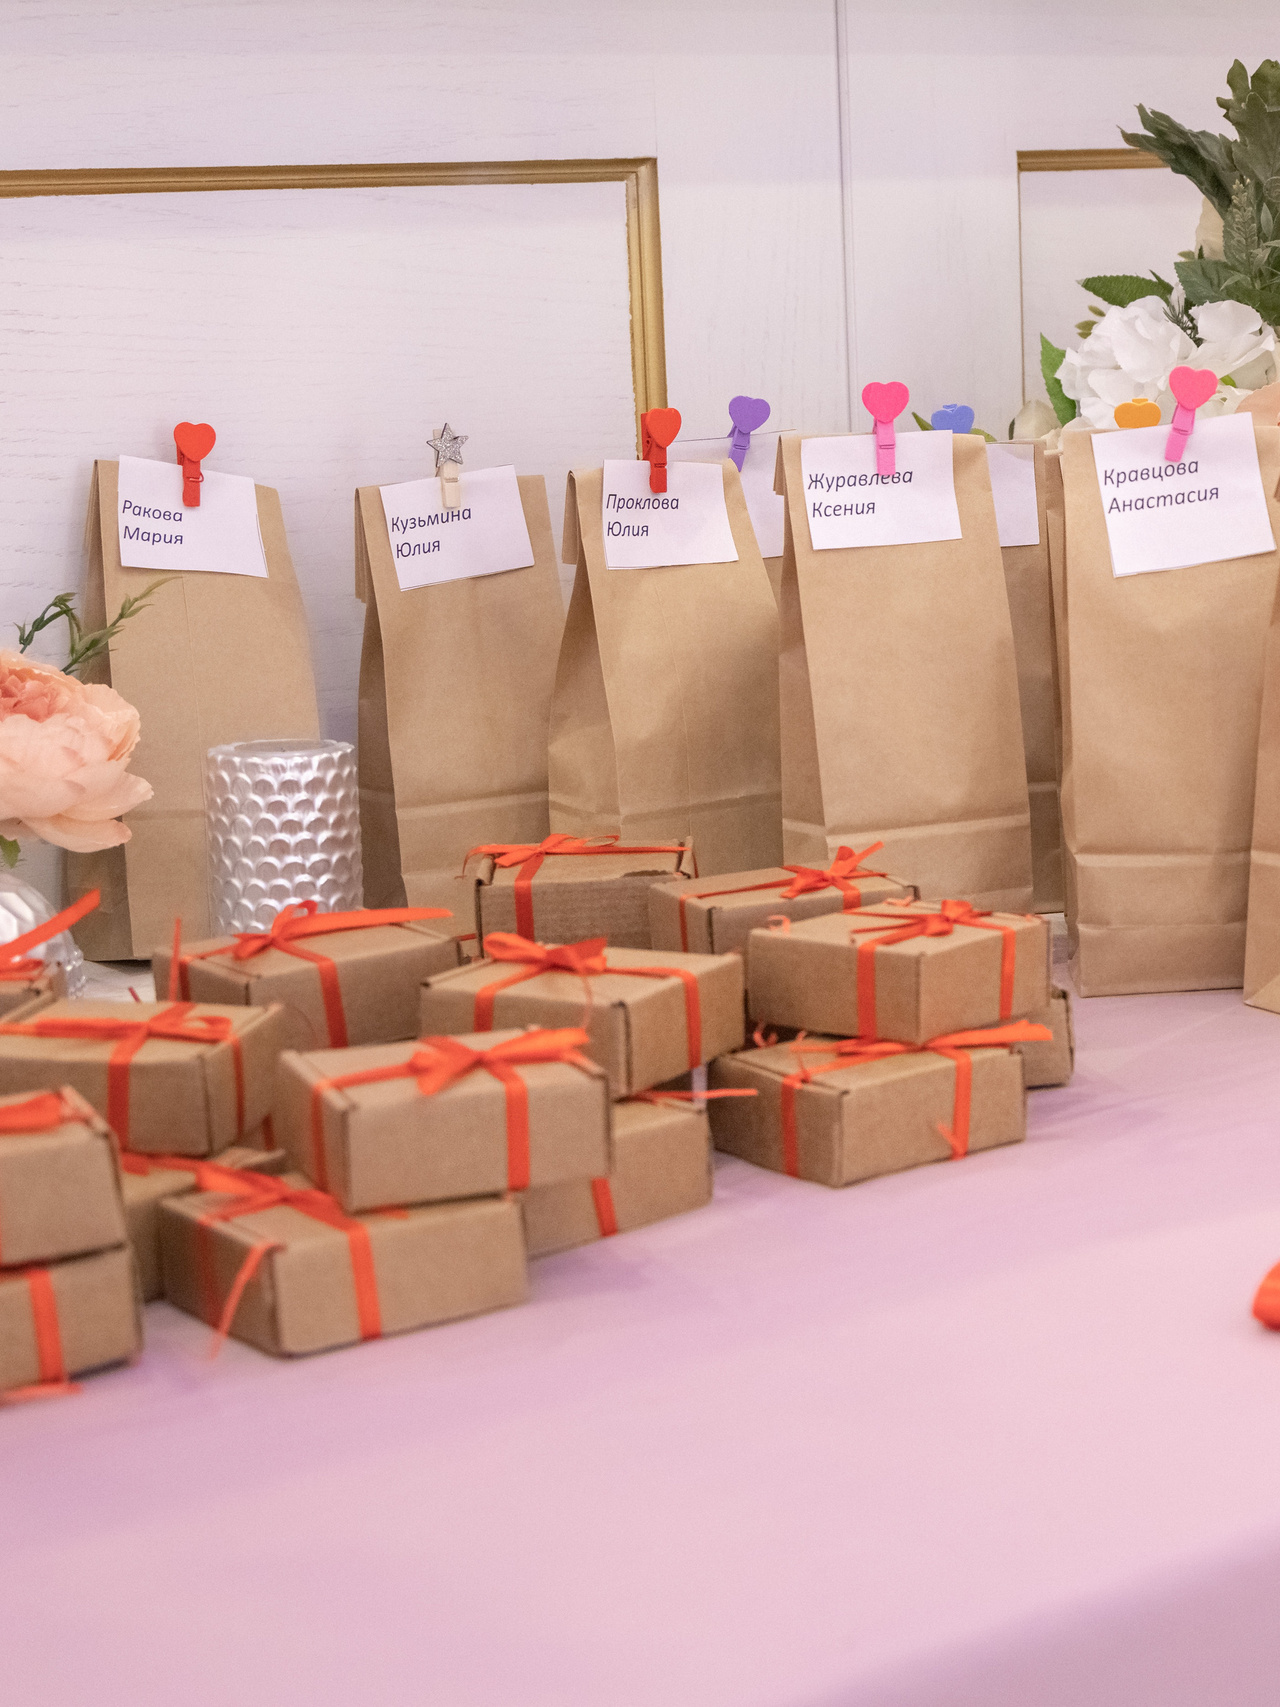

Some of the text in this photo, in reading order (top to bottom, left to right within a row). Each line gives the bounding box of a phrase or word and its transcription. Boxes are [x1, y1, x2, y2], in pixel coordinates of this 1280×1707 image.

[807, 469, 914, 493] Журавлева
[1103, 460, 1199, 488] Кравцова
[122, 499, 183, 522] Ракова
[605, 493, 680, 513] Проклова
[811, 501, 876, 518] Ксения
[1107, 487, 1220, 514] Анастасия
[391, 507, 472, 535] Кузьмина
[607, 521, 650, 537] Юлия
[123, 525, 184, 546] Мария
[396, 539, 441, 559] Юлия
